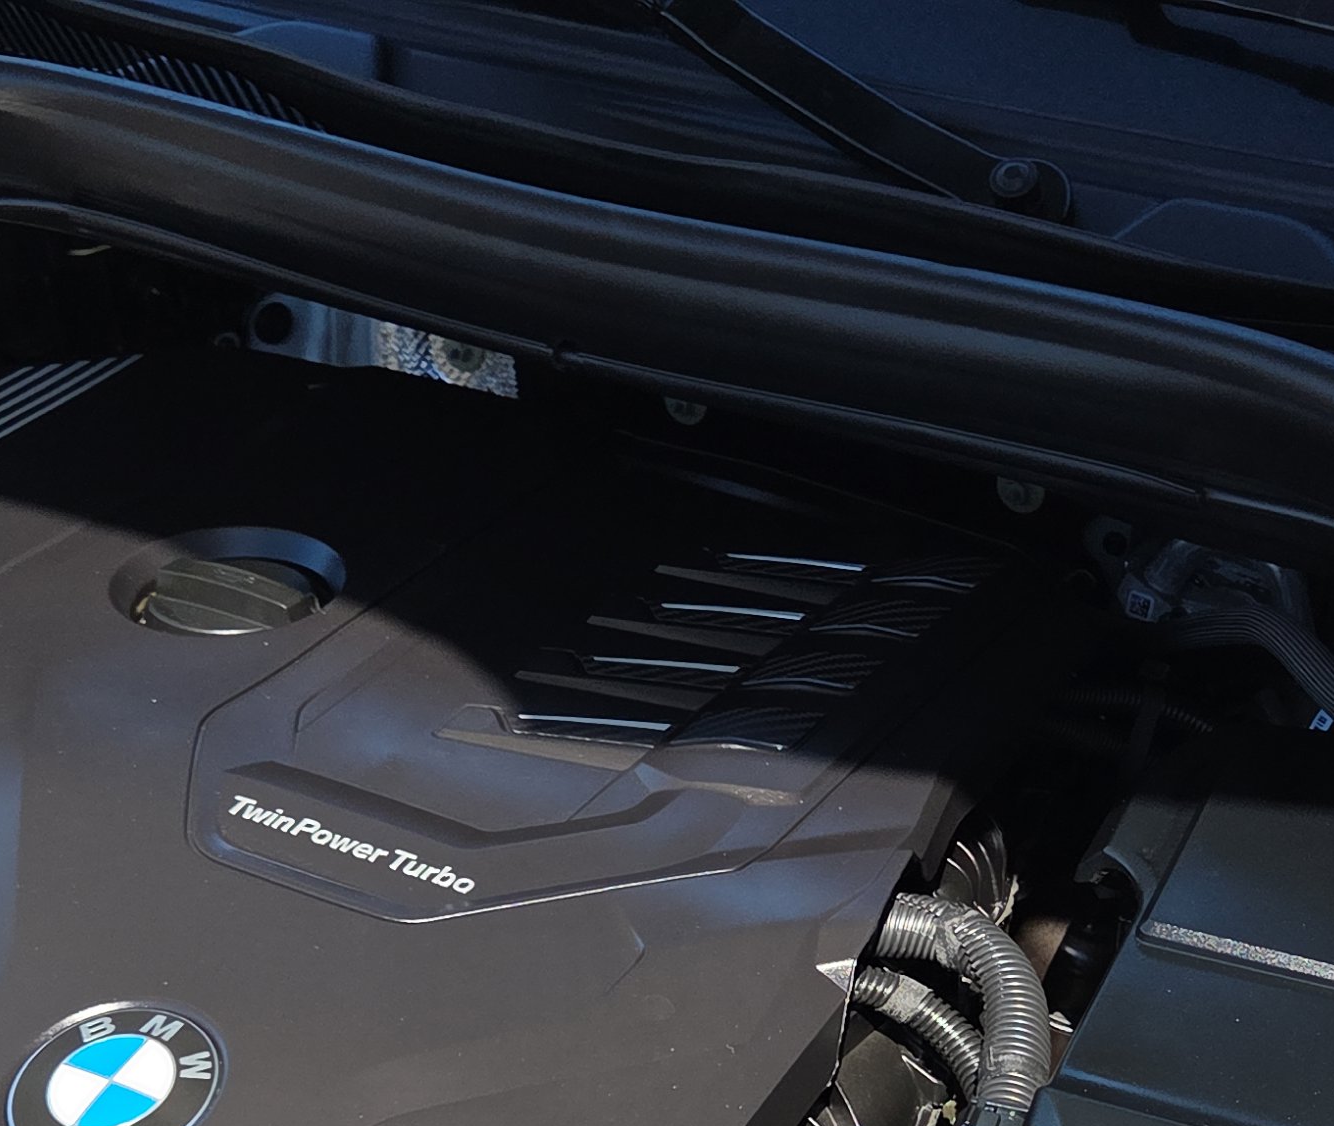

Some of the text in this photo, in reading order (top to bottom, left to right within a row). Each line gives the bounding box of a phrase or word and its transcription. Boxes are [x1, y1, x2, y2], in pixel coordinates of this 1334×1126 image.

[228, 794, 476, 894] TwinPower Turbo
[79, 1014, 213, 1081] BMW
